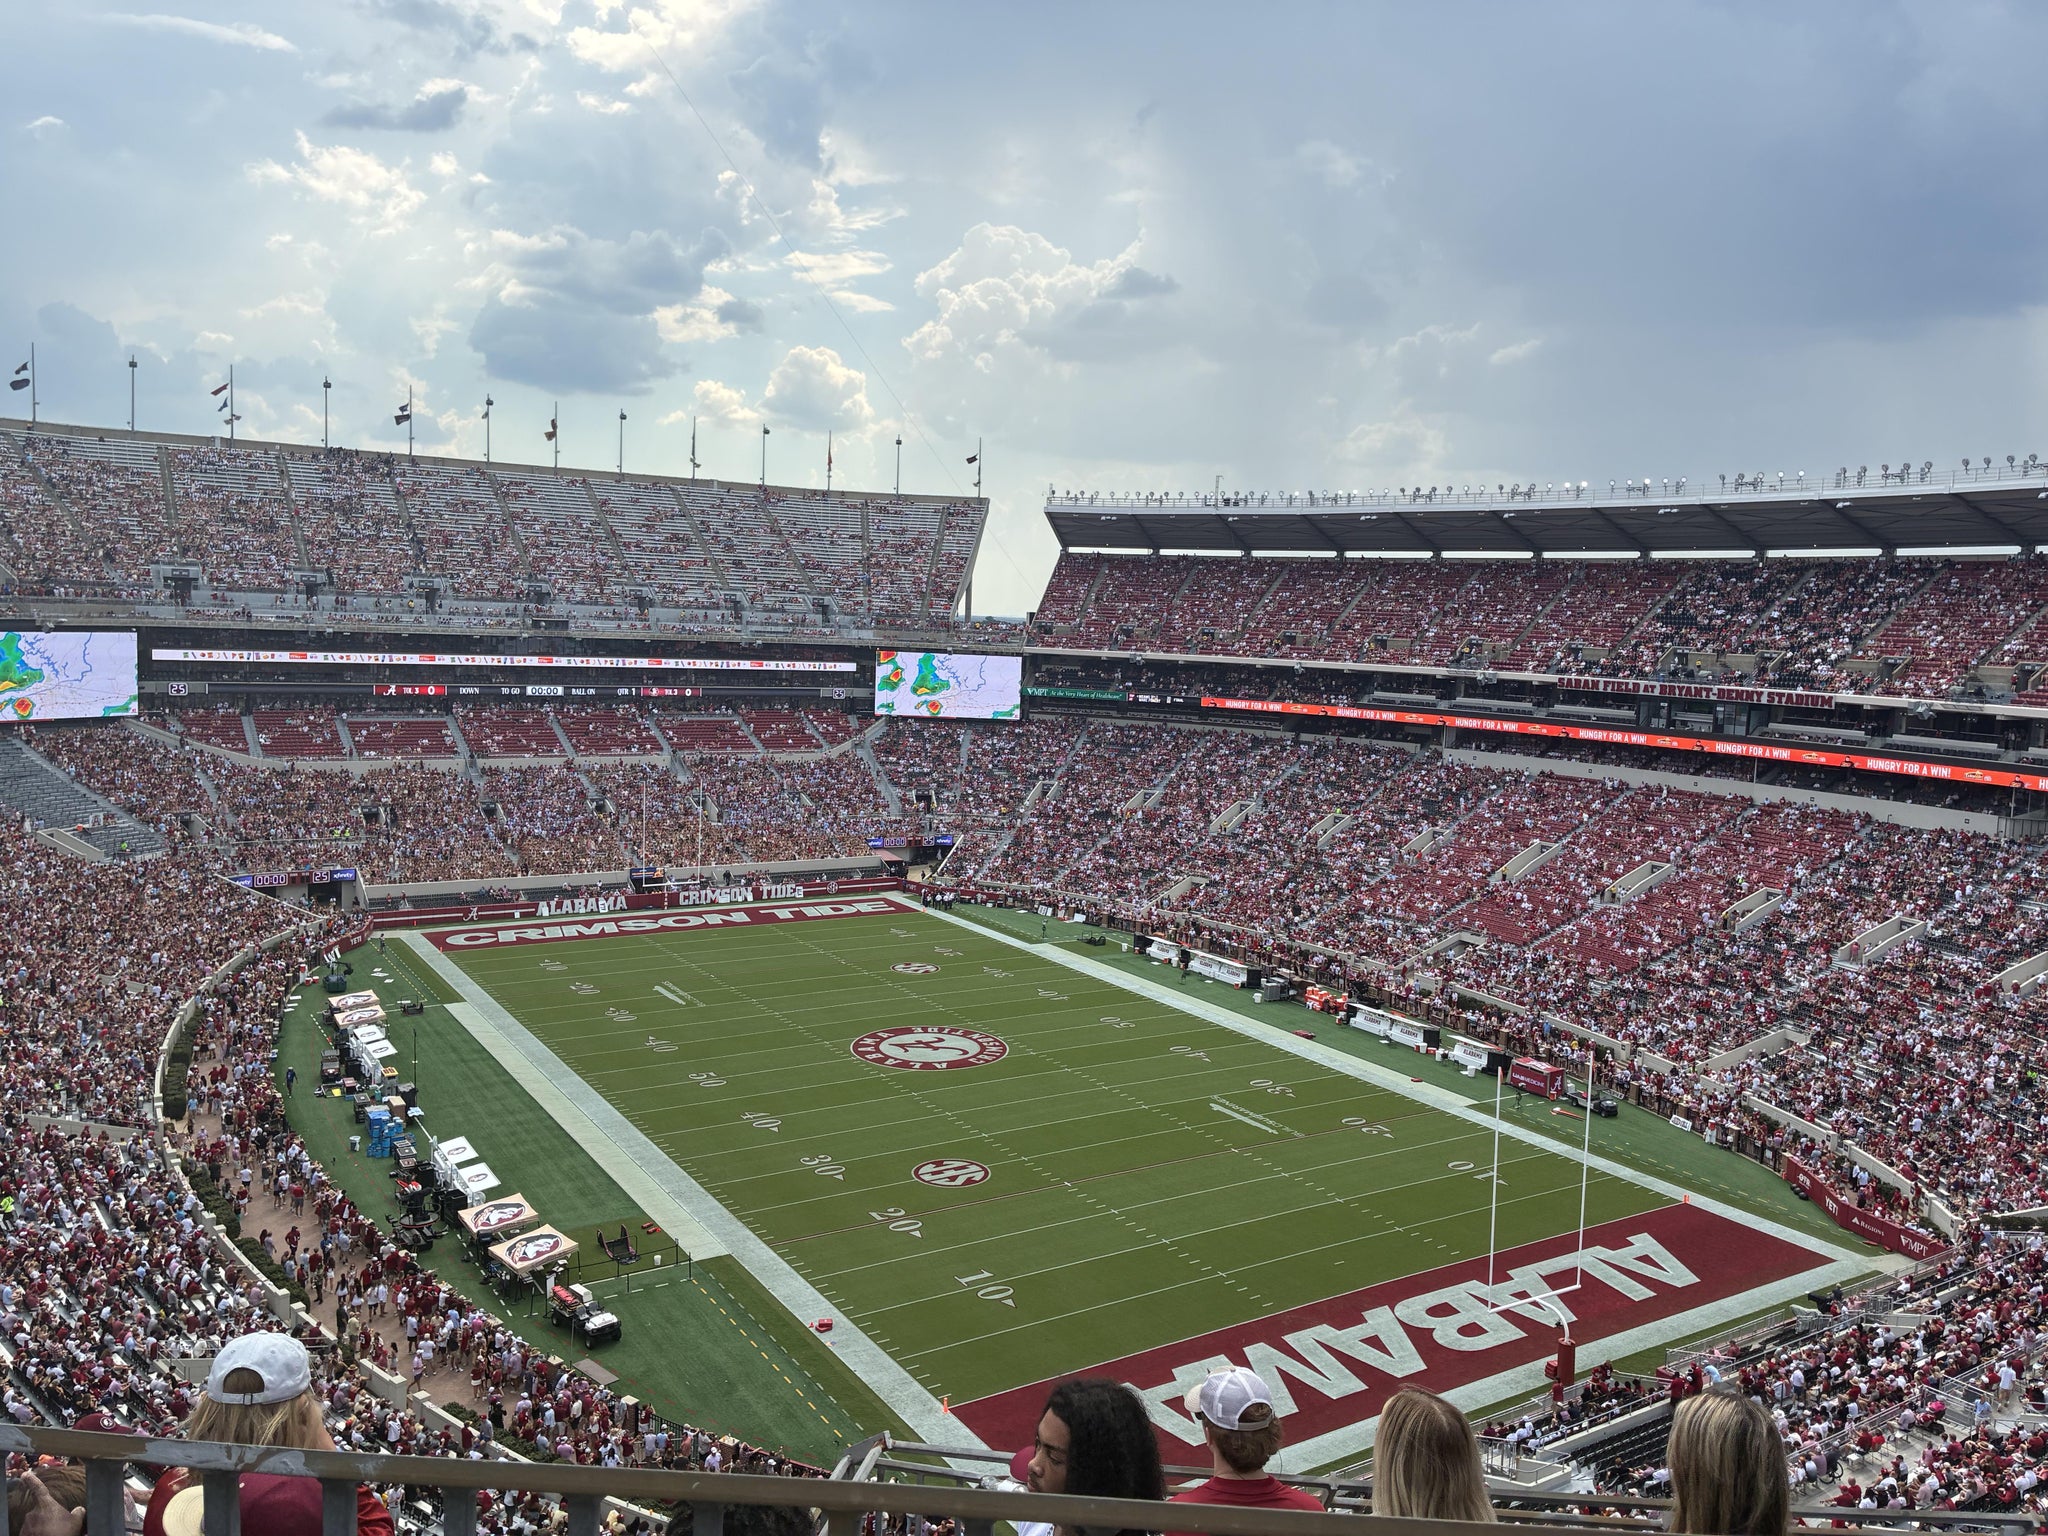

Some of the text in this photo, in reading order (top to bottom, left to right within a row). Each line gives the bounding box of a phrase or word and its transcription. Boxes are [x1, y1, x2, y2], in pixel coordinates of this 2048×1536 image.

[171, 684, 185, 694] 25
[427, 686, 435, 695] 0
[531, 687, 559, 695] 00:00
[632, 688, 636, 696] 1
[685, 688, 692, 696] 0
[1557, 678, 1834, 708] SABAN FIELD AT BRYANT-DENNY STADIUM
[1225, 700, 1249, 709] HUNGRY
[1251, 702, 1261, 710] FOR
[1262, 703, 1267, 711] A
[1268, 703, 1282, 712] WIN!
[1337, 708, 1362, 718] HUNGRY
[1363, 710, 1375, 719] FOR
[1382, 712, 1397, 721] WIN!
[1455, 718, 1482, 728] HUNGRY
[1483, 720, 1495, 729] FOR
[1496, 722, 1501, 730] A
[1503, 722, 1518, 732] WIN!
[1579, 730, 1607, 741] HUNGRY
[1609, 733, 1623, 742] FOR
[1624, 735, 1629, 743] A
[1631, 735, 1647, 744] WIN!
[1715, 742, 1747, 755] HUNGRY
[1749, 746, 1763, 757] FOR
[1765, 749, 1771, 757] A
[1772, 749, 1791, 759] WIN!
[1867, 759, 1902, 772] HUNGRY
[1903, 762, 1920, 774] FOR
[1921, 765, 1928, 775] A
[1930, 765, 1952, 778] WIN!
[256, 875, 286, 886] 00:00
[314, 872, 329, 882] 25
[333, 871, 354, 880] xfinity
[679, 887, 754, 906] CRIMSON
[759, 884, 796, 900] TIDE
[536, 896, 628, 917] ALABAMA
[446, 901, 896, 945] CRIMSON TIDE
[604, 1009, 638, 1022] 30
[1364, 1015, 1382, 1026] ALABAMA
[911, 1027, 965, 1037] TIDE
[1400, 1027, 1419, 1039] ALABAMA
[644, 1040, 679, 1053] 40
[857, 1031, 948, 1069] ALABAMA
[968, 1033, 1004, 1064] CRIMSON
[1462, 1048, 1483, 1060] ALABAMA
[688, 1071, 728, 1088] 50
[1249, 1079, 1293, 1095] 30
[740, 1112, 783, 1128] 40
[1341, 1117, 1392, 1135] 20
[800, 1154, 847, 1177] 30
[1447, 1161, 1502, 1182] 10
[1825, 1196, 1839, 1216] YETI
[868, 1207, 923, 1232] 20
[954, 1268, 1015, 1301] 10
[1122, 1232, 1701, 1447] ALABAMA
